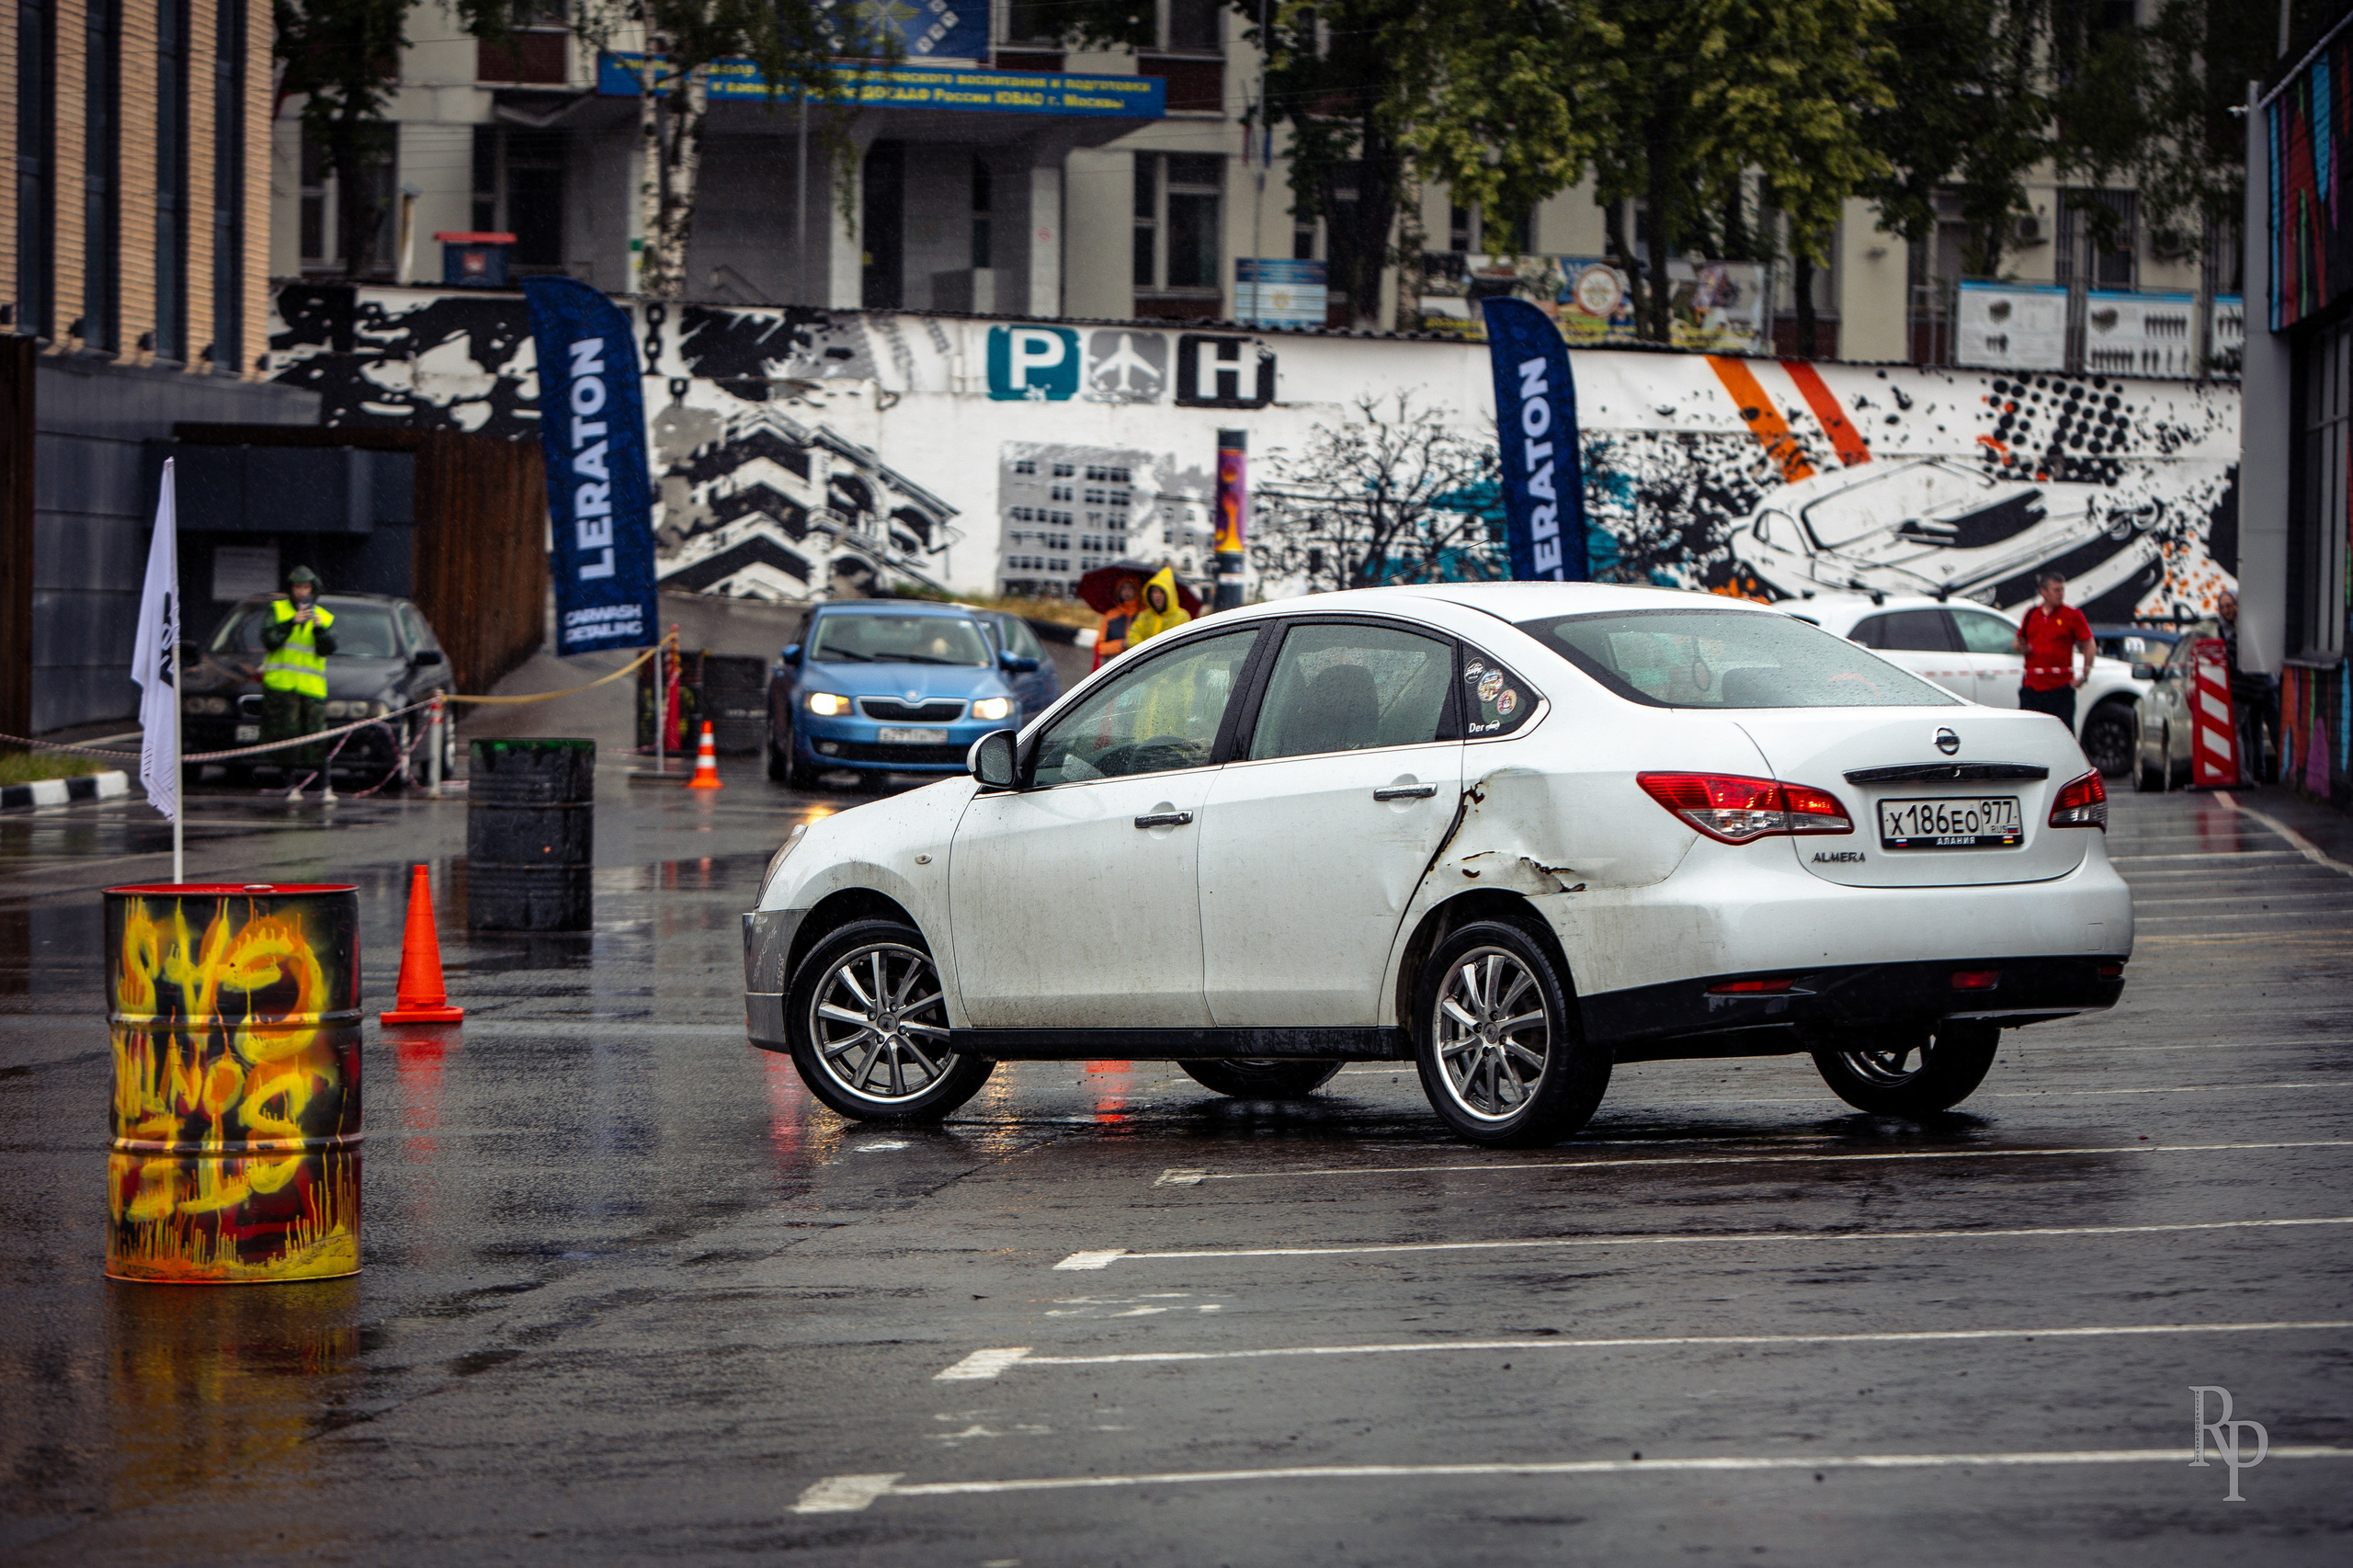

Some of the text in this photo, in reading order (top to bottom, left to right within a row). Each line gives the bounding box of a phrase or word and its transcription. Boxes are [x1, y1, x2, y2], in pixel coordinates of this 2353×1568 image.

[1010, 328, 1066, 391] P
[1198, 342, 1258, 400] H
[569, 336, 616, 582] LERATON
[1518, 357, 1564, 583] ERATON
[564, 604, 642, 627] CARWASH
[1469, 722, 1485, 733] Der
[1982, 801, 2013, 824] 977
[1991, 824, 2007, 834] RUS
[1936, 836, 1976, 846] АЛАНИЯ
[1811, 851, 1867, 863] ALMERA
